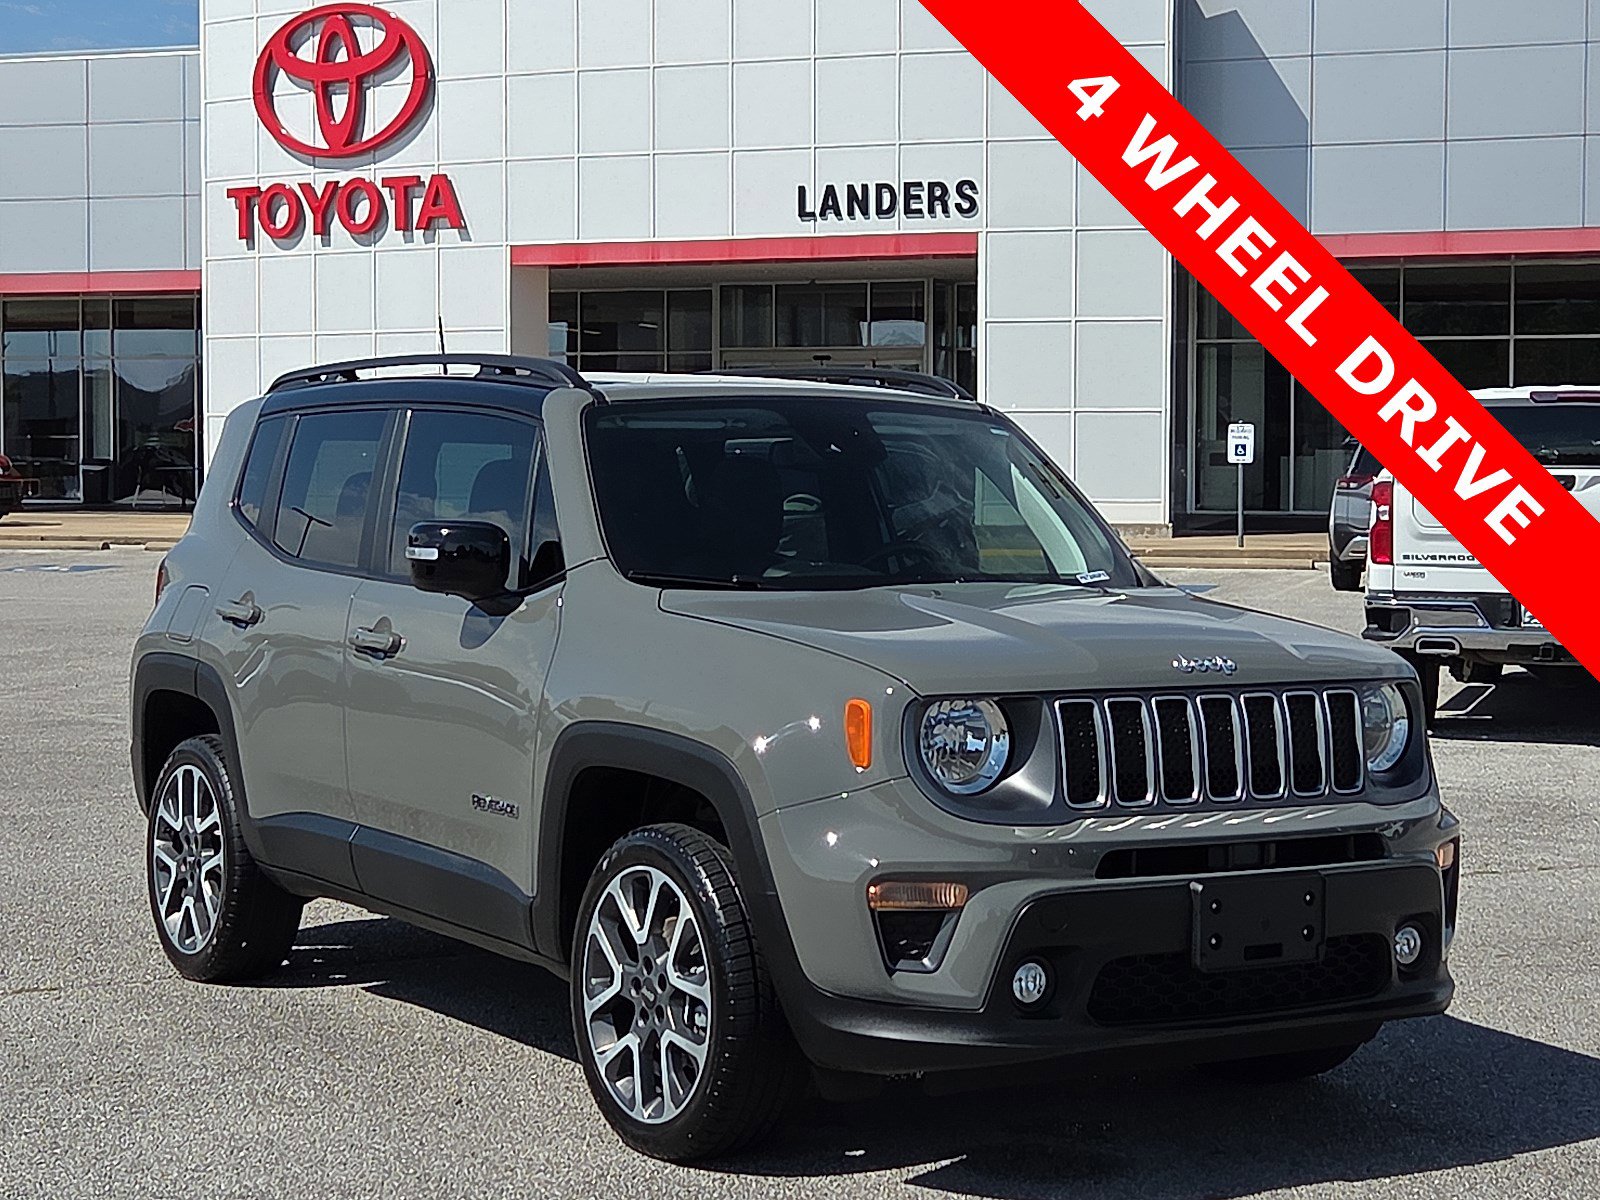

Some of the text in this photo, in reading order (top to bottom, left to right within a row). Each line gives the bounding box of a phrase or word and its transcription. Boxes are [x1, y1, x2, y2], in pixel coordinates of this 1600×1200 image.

[227, 174, 465, 242] TOYOTA
[798, 180, 979, 221] LANDERS
[1402, 554, 1475, 562] SILVERADO
